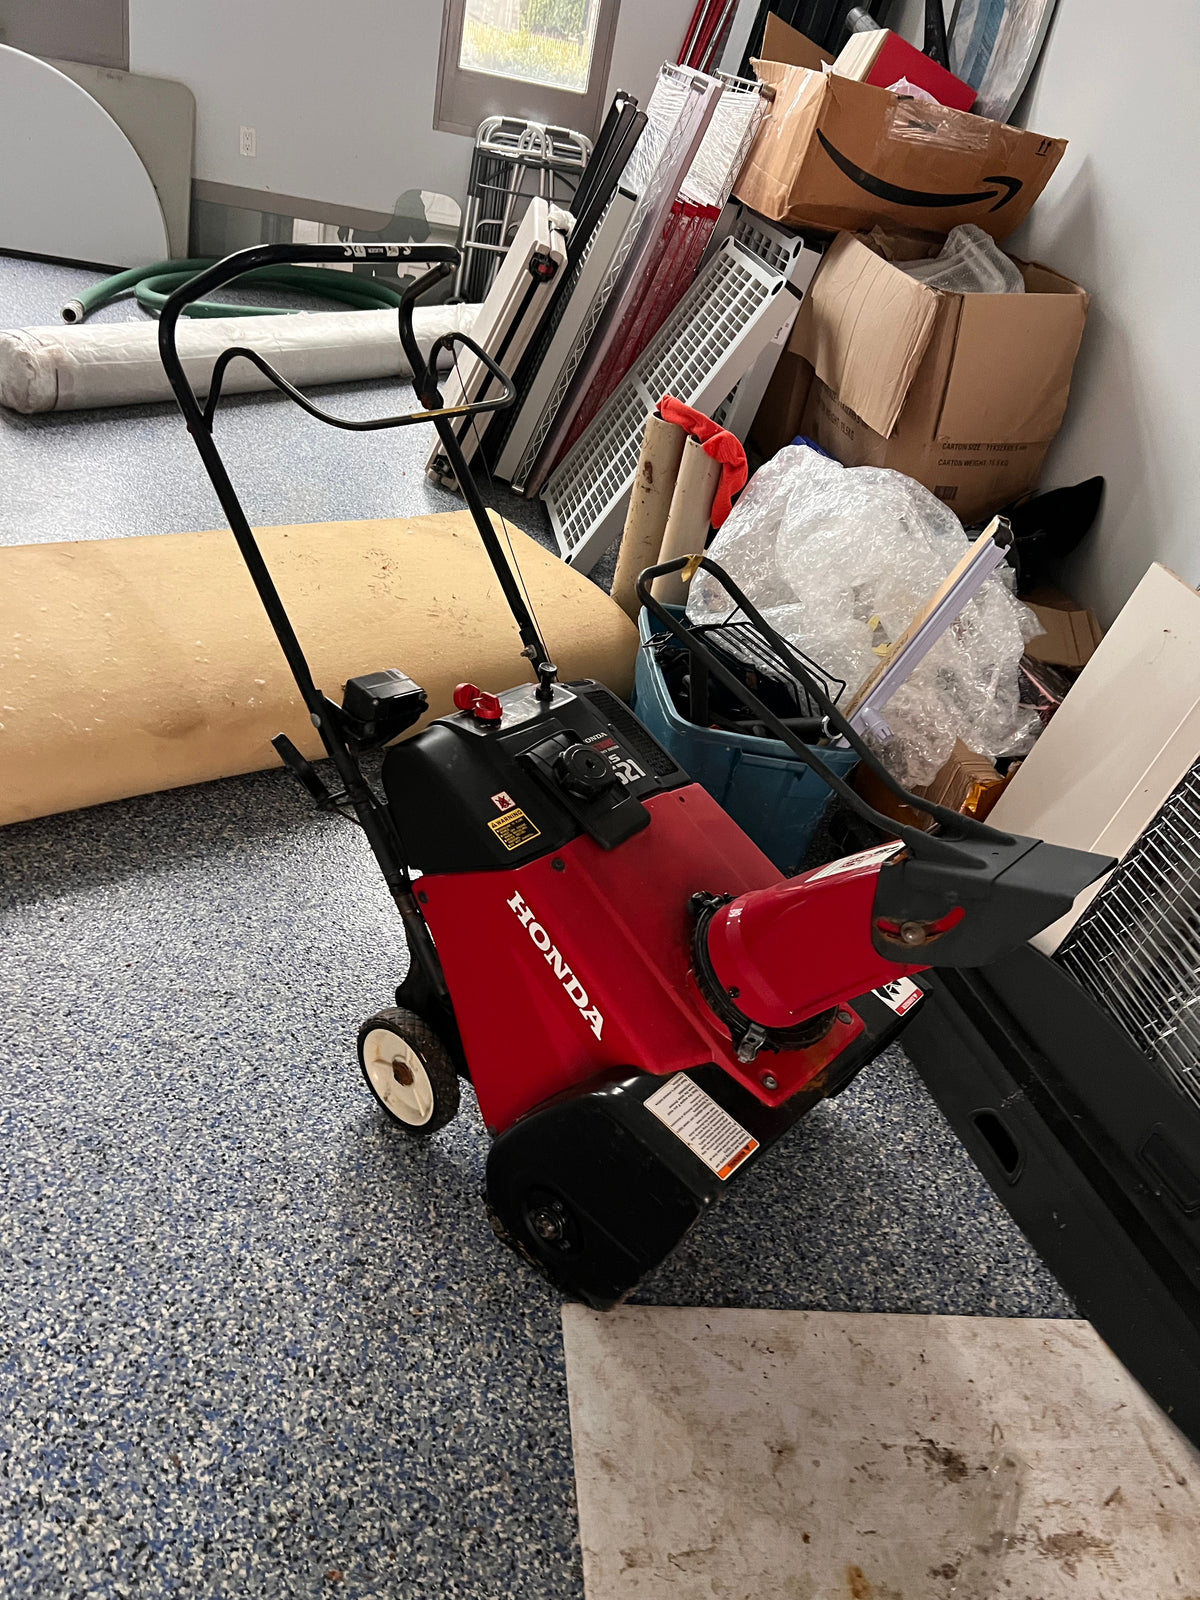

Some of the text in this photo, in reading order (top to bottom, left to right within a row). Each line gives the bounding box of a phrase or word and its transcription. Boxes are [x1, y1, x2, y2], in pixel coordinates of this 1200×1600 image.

[942, 442, 967, 451] CARTON
[937, 459, 962, 467] CARTON
[583, 732, 608, 744] ONDA
[496, 809, 524, 825] WARNING
[506, 890, 604, 1041] HONDA
